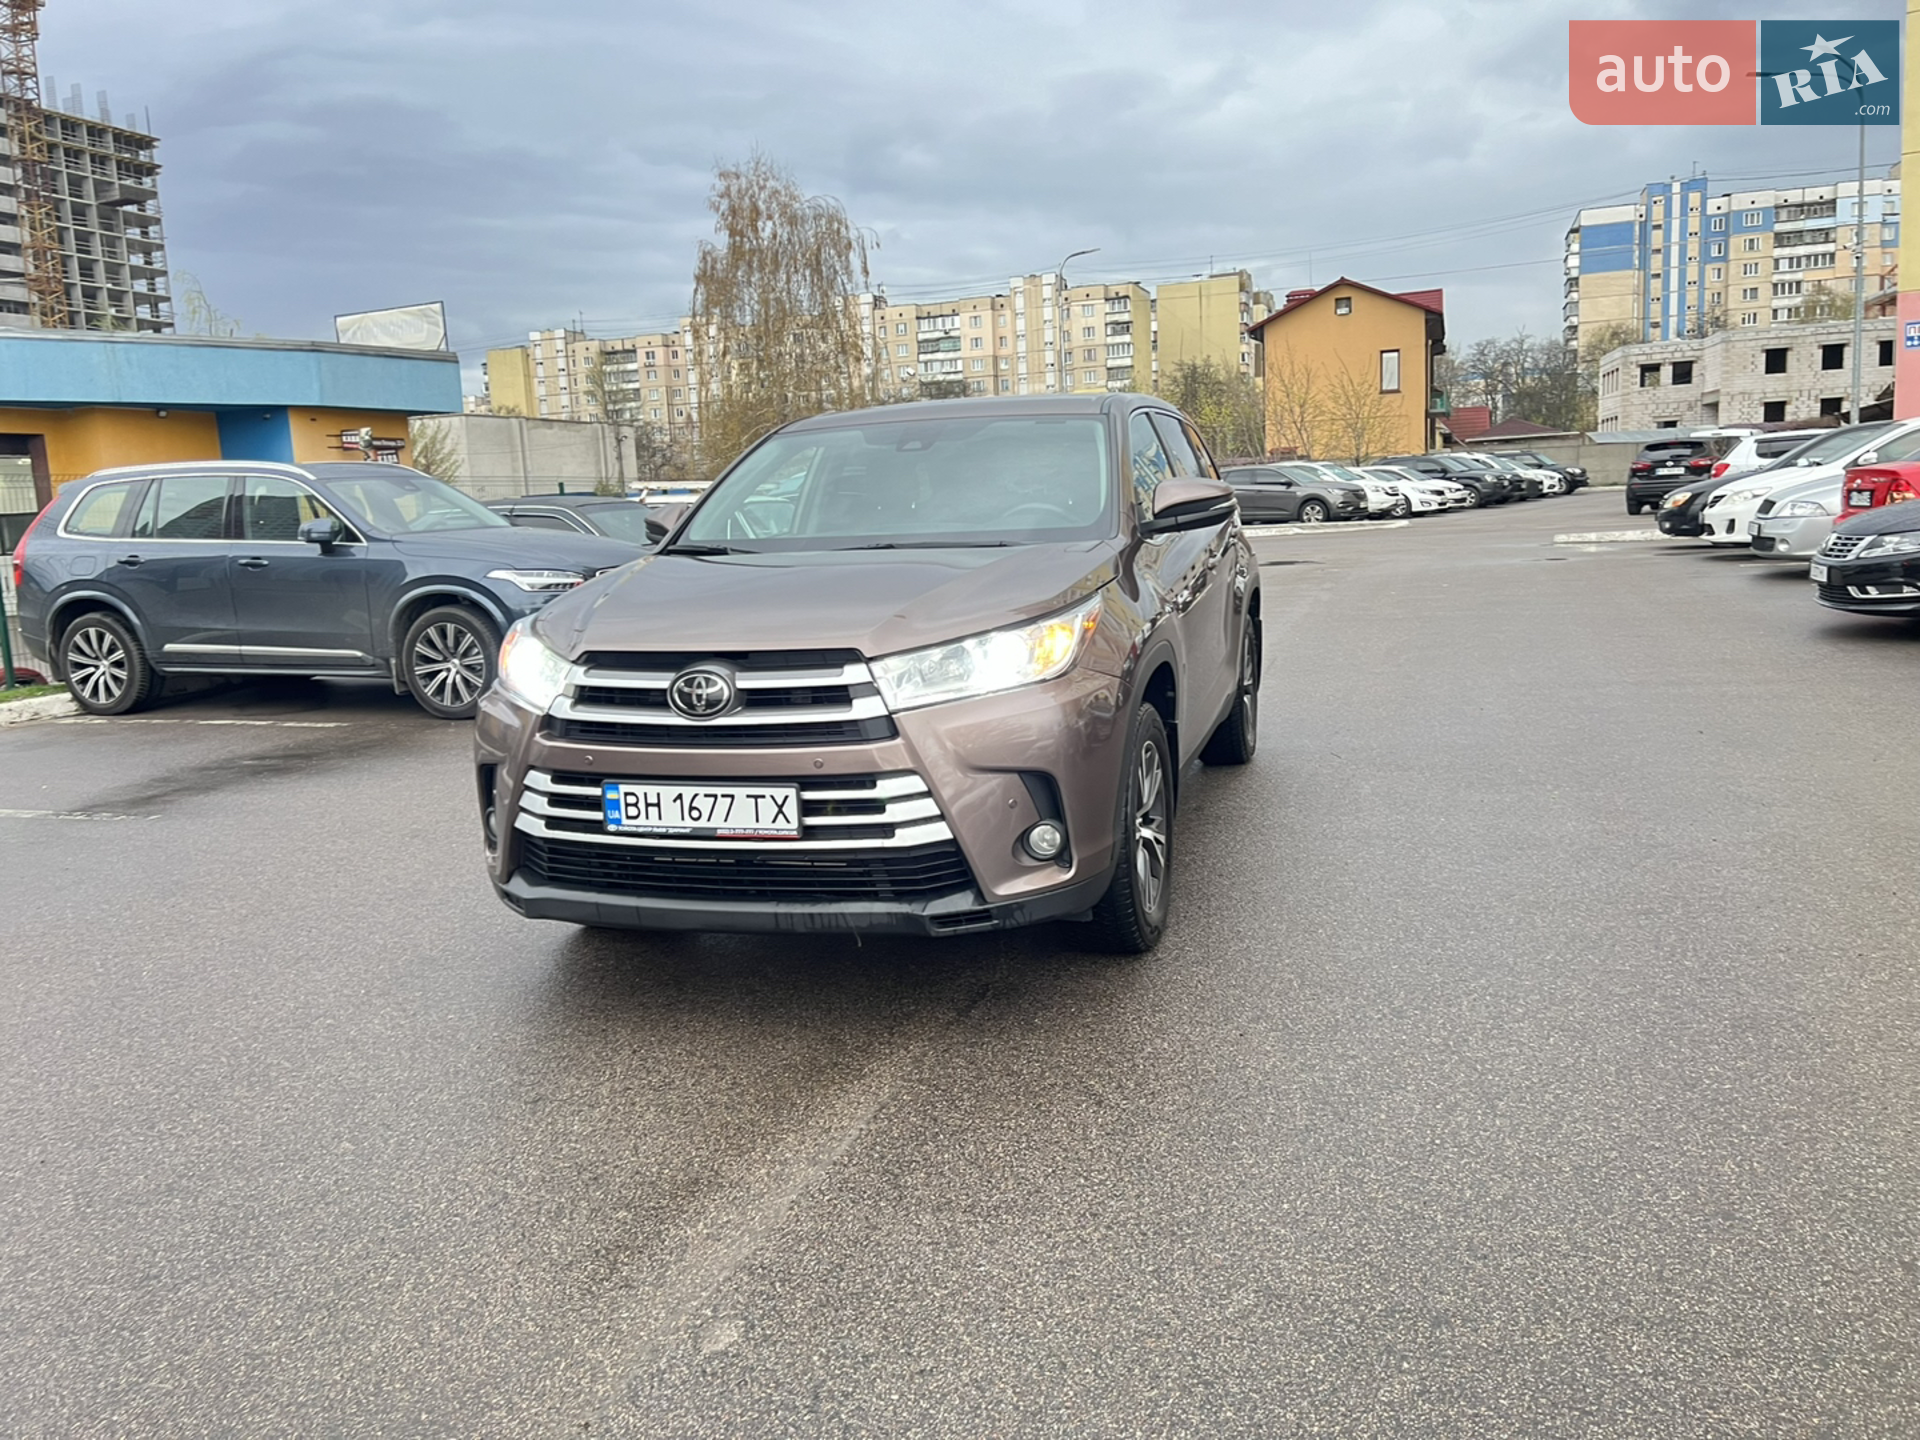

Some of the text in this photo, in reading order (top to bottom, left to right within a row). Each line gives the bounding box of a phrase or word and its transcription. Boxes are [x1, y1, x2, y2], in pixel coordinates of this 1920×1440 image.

[607, 810, 621, 820] UA
[624, 792, 791, 824] BH 1677 TX
